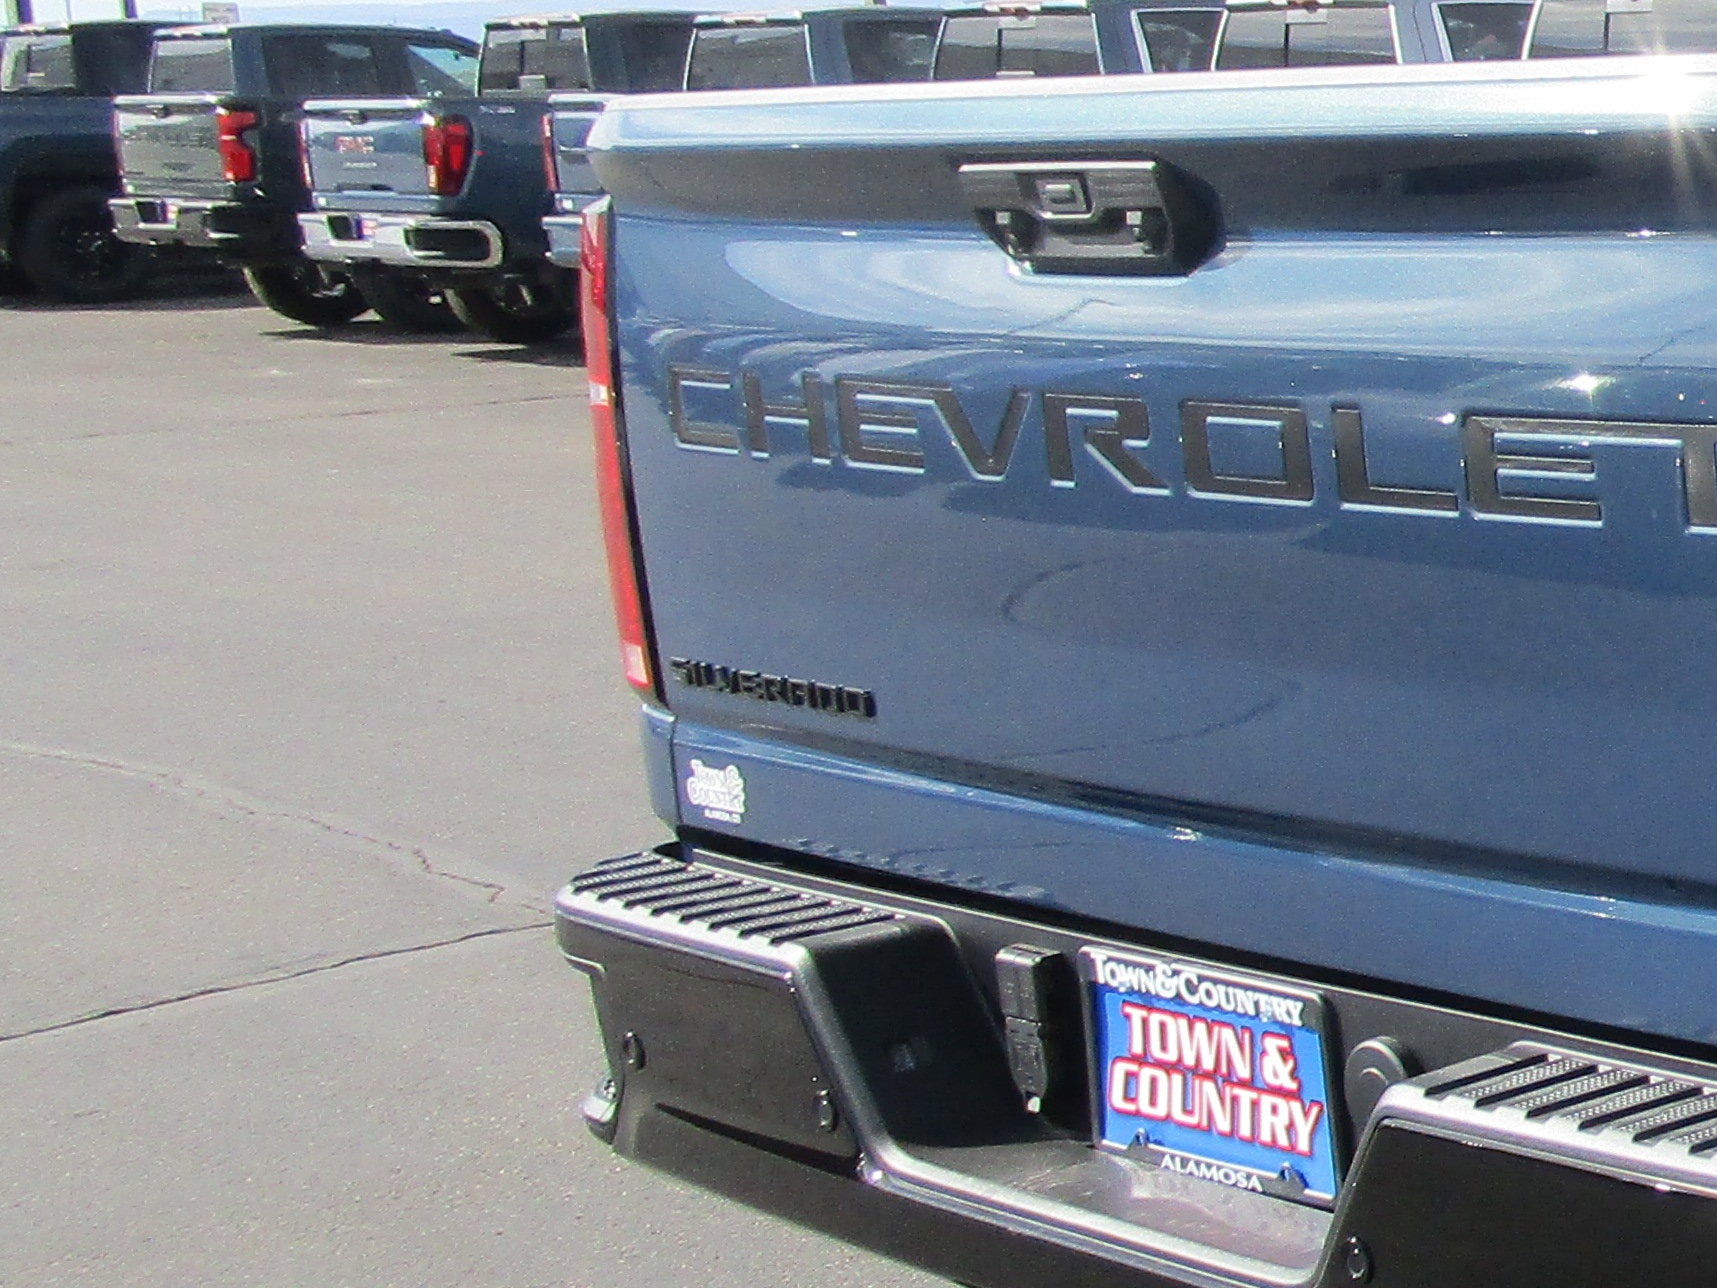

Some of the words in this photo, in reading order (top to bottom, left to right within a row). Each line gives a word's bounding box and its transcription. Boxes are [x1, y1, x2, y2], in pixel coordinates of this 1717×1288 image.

[1121, 1000, 1254, 1084] TOWN
[1260, 1031, 1299, 1093] &
[1109, 1056, 1323, 1157] COUNTRY
[1160, 1153, 1263, 1193] ALAMOSA
